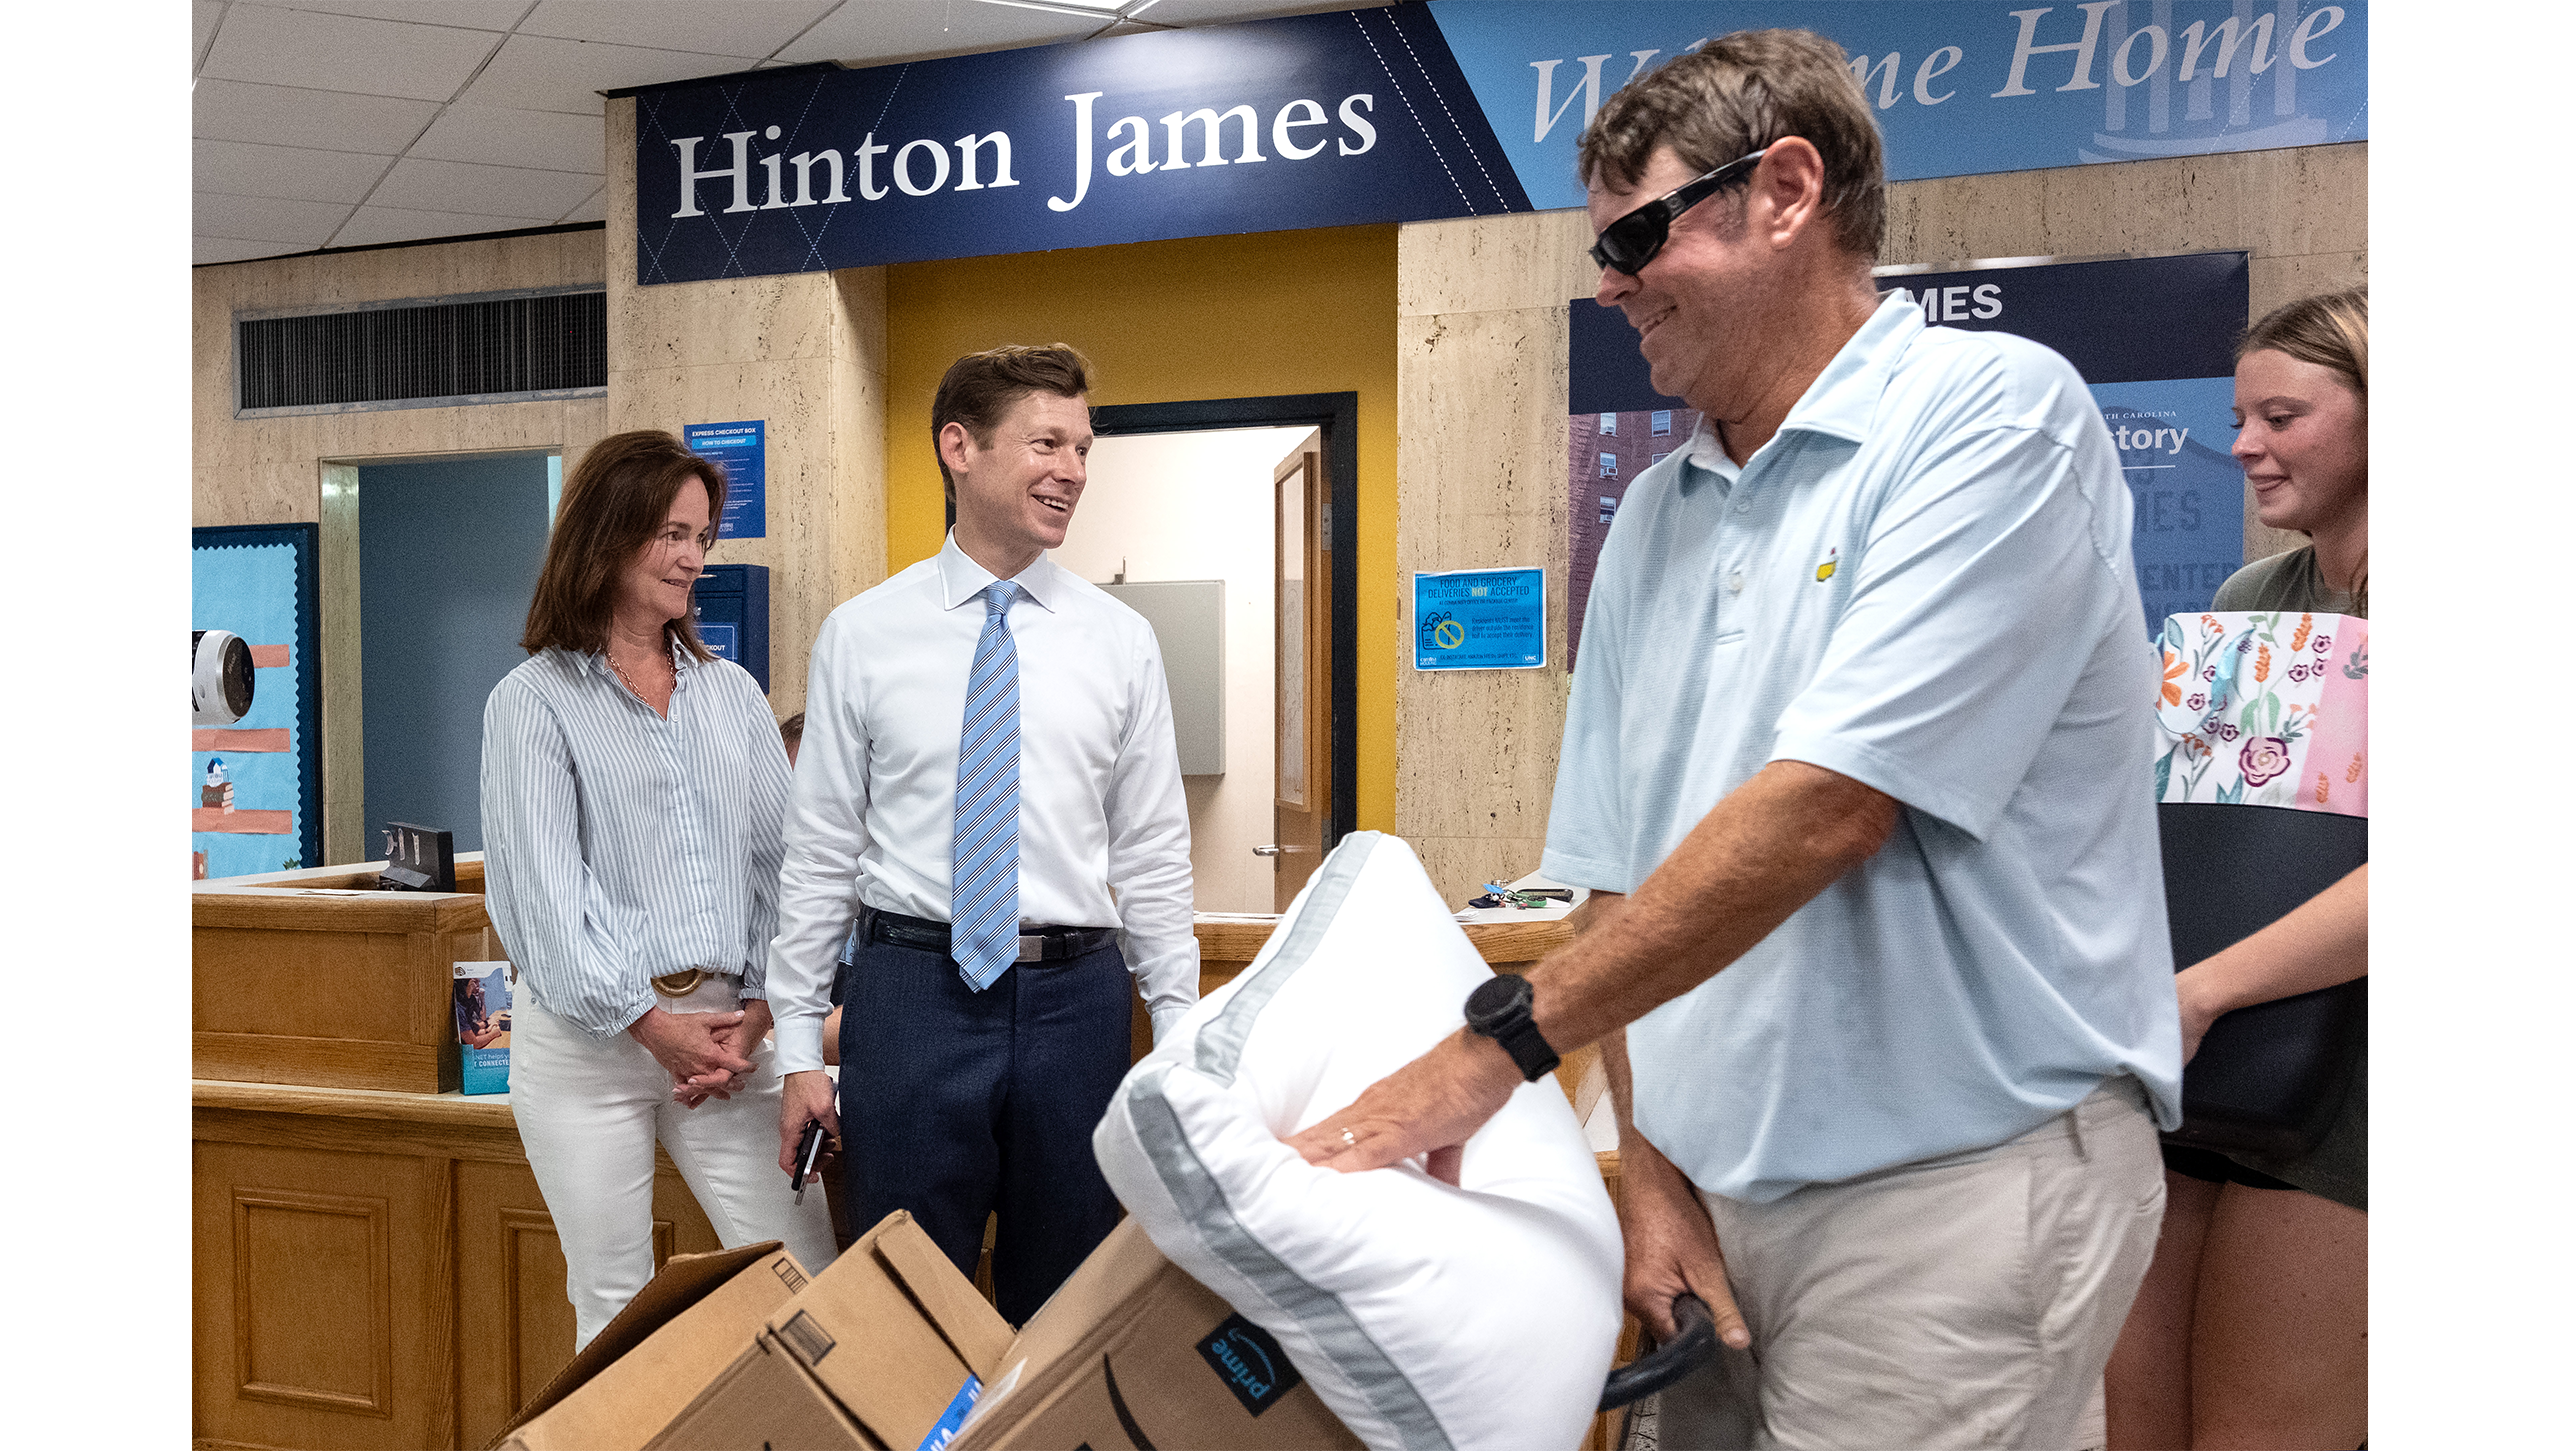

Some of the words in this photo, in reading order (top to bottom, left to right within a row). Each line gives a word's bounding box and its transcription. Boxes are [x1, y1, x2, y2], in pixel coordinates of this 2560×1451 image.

[1991, 0, 2345, 98] Home
[671, 125, 1020, 218] Hinton
[1047, 91, 1377, 212] James
[1905, 284, 2003, 322] MES
[2123, 410, 2177, 419] CAROLINA
[715, 428, 744, 436] CHECKOUT
[2115, 425, 2189, 455] tory
[1428, 588, 1470, 599] DELIVERIES
[1471, 587, 1488, 597] NOT
[1490, 585, 1530, 597] ACCEPTED
[1440, 579, 1461, 589] FOOD
[1462, 578, 1479, 588] AND
[1480, 576, 1517, 587] GROCERY
[1211, 1338, 1271, 1400] prime
